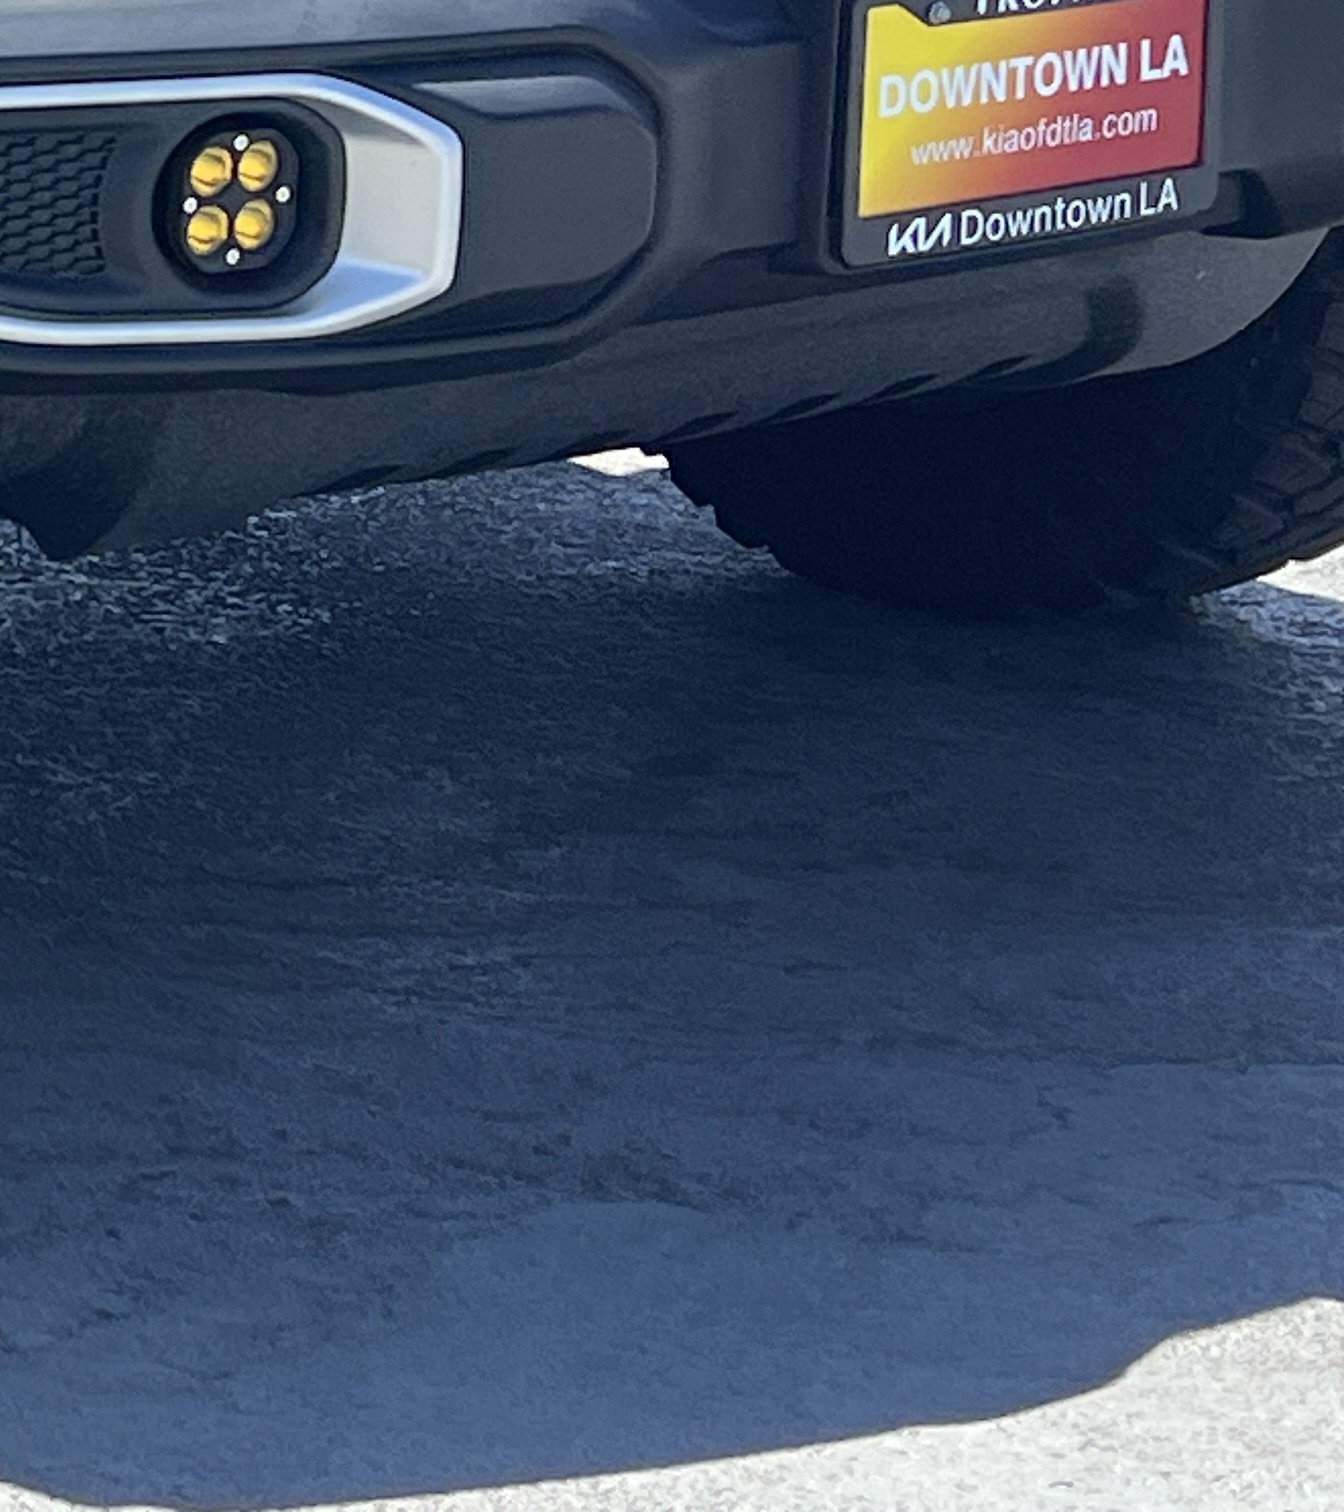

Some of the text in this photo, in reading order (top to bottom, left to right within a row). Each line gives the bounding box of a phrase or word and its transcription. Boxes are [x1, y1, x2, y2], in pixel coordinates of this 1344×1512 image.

[878, 33, 1190, 119] DOWNTOWN LA
[910, 106, 1159, 167] www.kiaofdtla.com
[960, 189, 1132, 247] Downtown
[1139, 177, 1180, 213] LA
